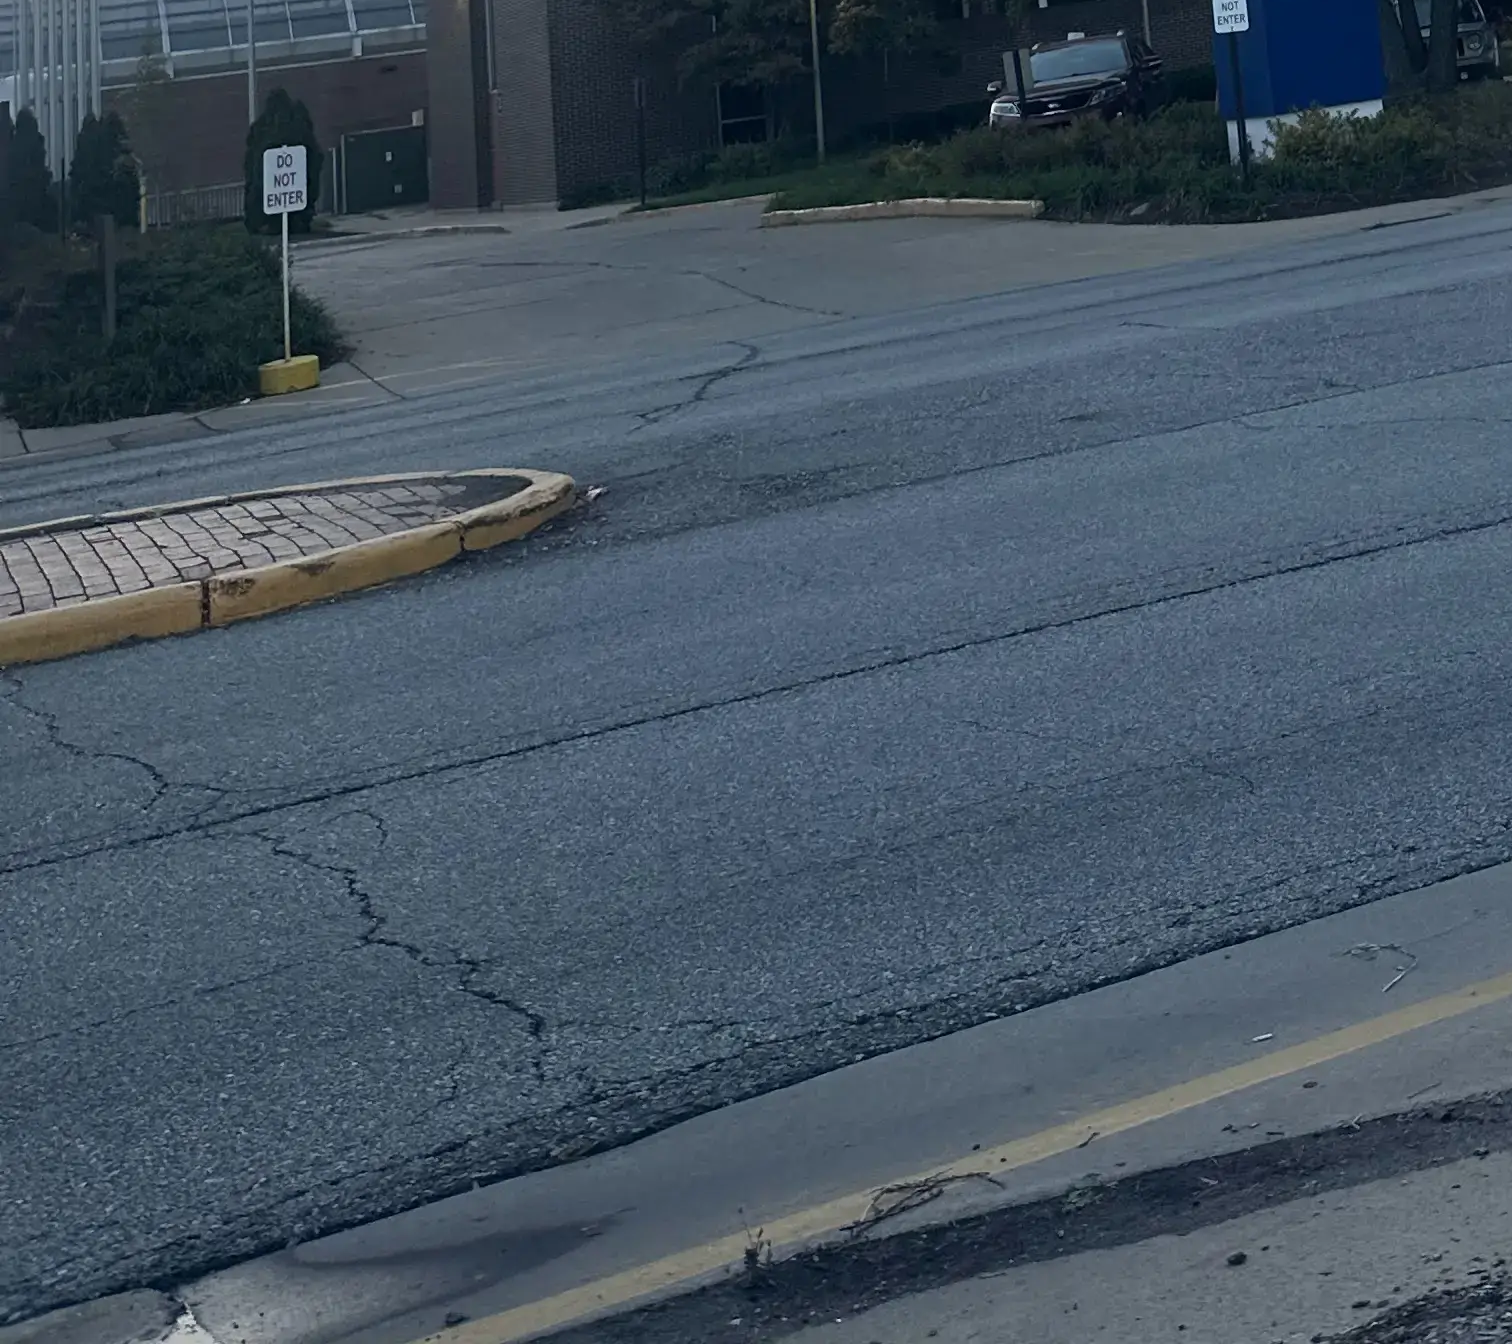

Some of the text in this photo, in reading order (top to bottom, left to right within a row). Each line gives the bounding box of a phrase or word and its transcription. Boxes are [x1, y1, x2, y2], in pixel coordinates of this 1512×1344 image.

[1221, 1, 1239, 12] NOT
[1217, 13, 1246, 26] ENTER
[277, 154, 293, 168] DO
[273, 172, 297, 188] NOT
[267, 190, 304, 208] ENTER
